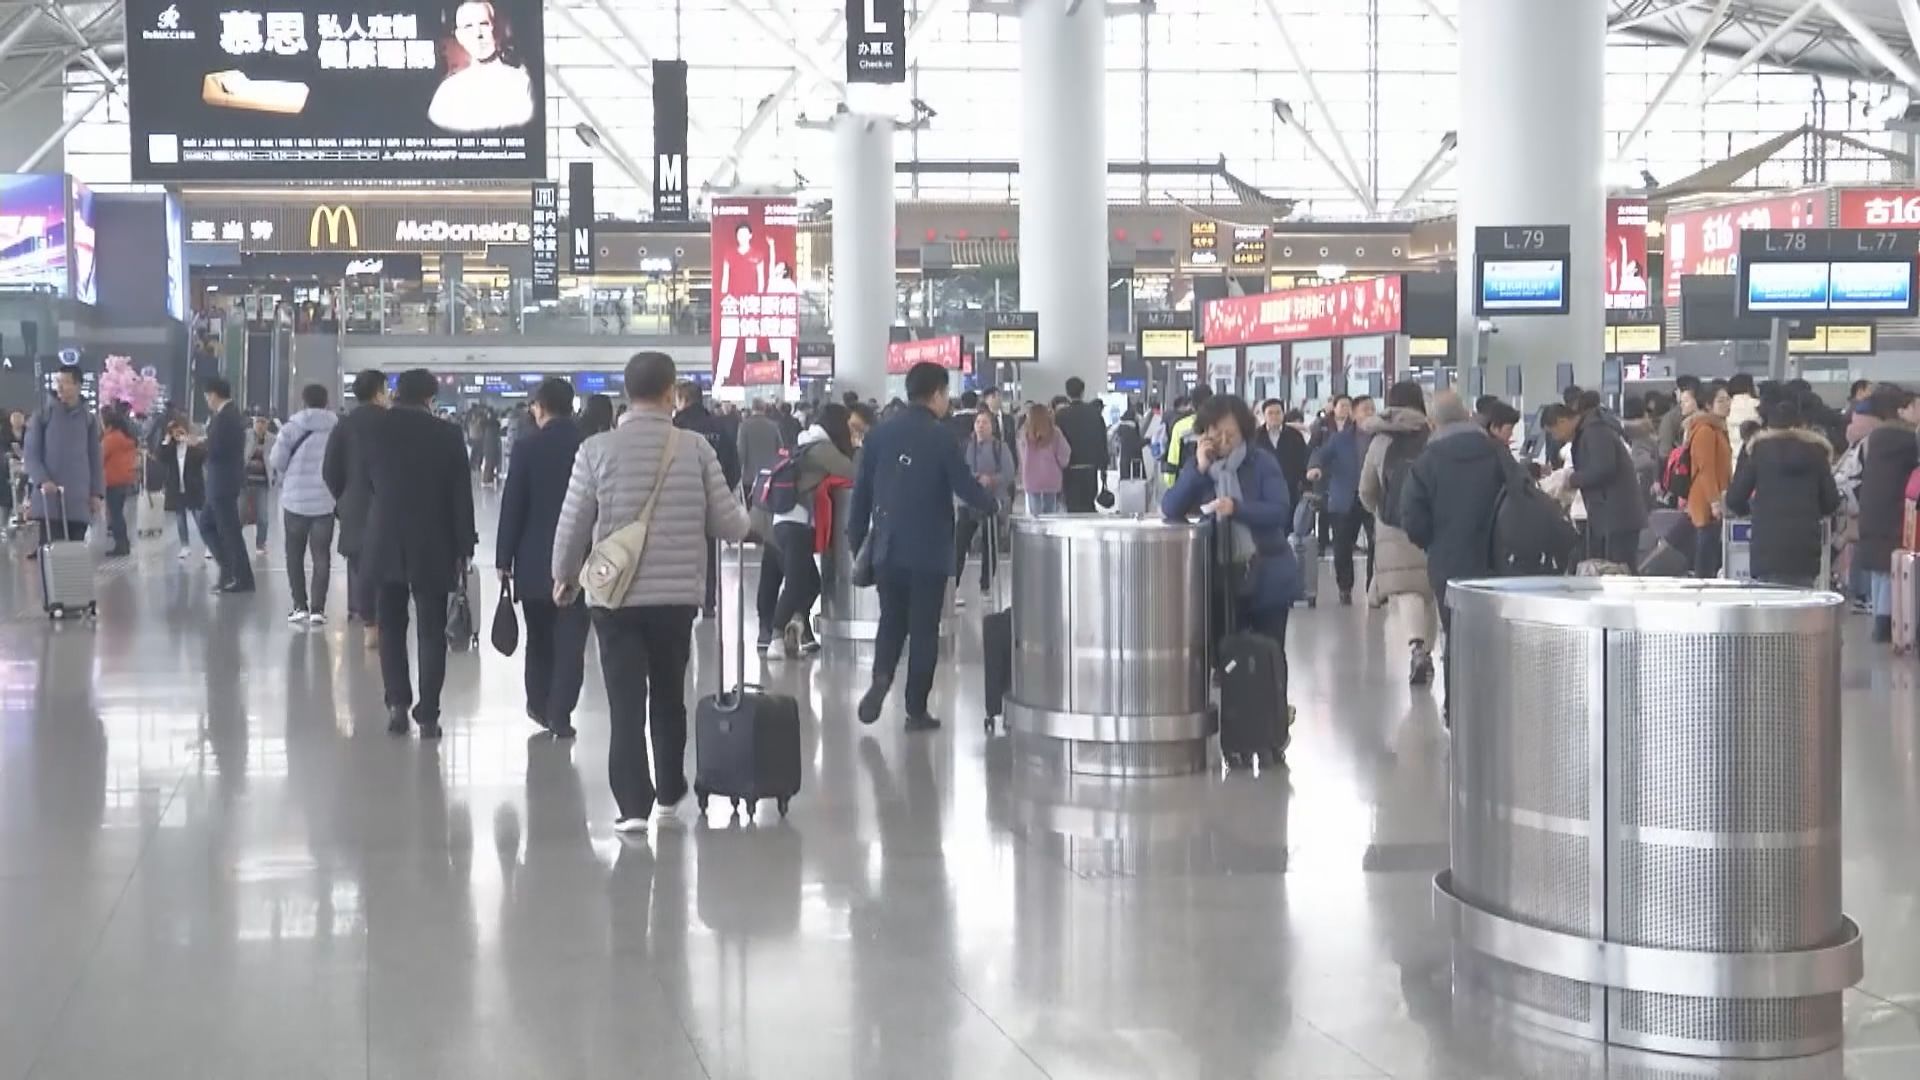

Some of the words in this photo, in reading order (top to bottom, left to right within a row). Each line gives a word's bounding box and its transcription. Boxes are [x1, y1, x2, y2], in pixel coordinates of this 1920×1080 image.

[864, 0, 886, 33] L
[857, 41, 894, 56] 办票区
[859, 60, 893, 70] Check-in
[660, 154, 682, 191] M
[396, 219, 531, 242] McDonald's
[1503, 230, 1545, 249] L.79
[575, 228, 589, 255] N
[1765, 233, 1807, 251] L.78
[1857, 232, 1898, 251] L.77
